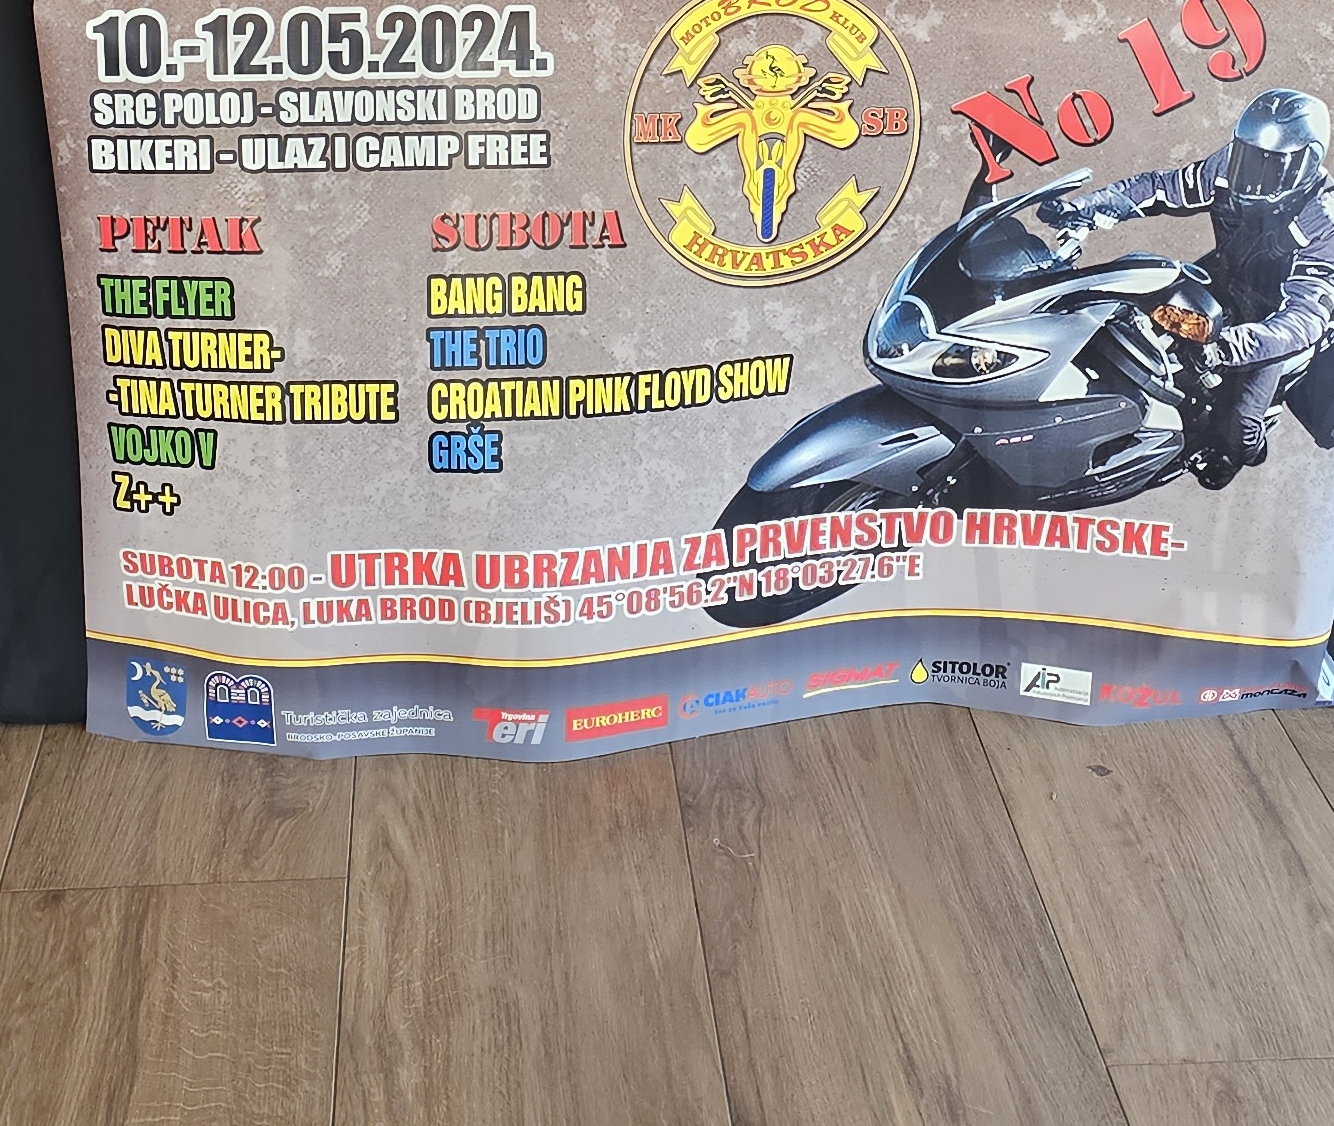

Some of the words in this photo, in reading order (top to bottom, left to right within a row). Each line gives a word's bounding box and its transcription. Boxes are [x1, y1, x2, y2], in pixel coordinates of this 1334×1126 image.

[86, 5, 555, 82] 10.-12.05.2024.
[679, 10, 722, 47] MOTO
[829, 9, 868, 45] KLUB
[91, 90, 155, 128] SRC
[162, 89, 256, 128] POLOJ
[278, 87, 447, 127] SLAVONSKI
[454, 84, 540, 124] BROD
[861, 107, 909, 136] SB
[633, 113, 682, 142] MK
[953, 74, 1114, 184] No
[90, 137, 213, 173] BIKERI
[241, 134, 331, 171] ULAZ
[336, 136, 348, 170] I
[353, 132, 461, 171] CAMP
[470, 131, 549, 167] FREE
[97, 214, 264, 255] PETAK
[431, 210, 626, 252] SUBOTA
[682, 223, 857, 273] HRVATSKA
[101, 278, 149, 316] THE
[156, 277, 233, 316] FLYER
[430, 277, 506, 315] BANG
[513, 276, 583, 314] BANG
[104, 331, 163, 368] DIVA
[169, 330, 283, 368] TURNER-
[431, 331, 478, 368] THE
[485, 330, 544, 366] TRIO
[107, 385, 176, 420] -TINA
[182, 384, 284, 421] TURNER
[290, 384, 397, 421] TRIBUTE
[430, 381, 560, 421] CROATIAN
[568, 377, 631, 415] PINK
[638, 370, 712, 412] FLOYD
[719, 358, 793, 399] SHOW
[112, 430, 194, 465] VOJKO
[198, 432, 216, 467] V
[432, 427, 500, 471] GRŠE
[113, 476, 180, 513] Z++
[123, 551, 227, 585] SUBOTA
[231, 563, 305, 590] 12:00
[330, 552, 463, 588] UTRKA
[475, 542, 672, 588] UBRZANJA
[683, 535, 729, 568] ZA
[737, 511, 954, 563] PRVENSTVO
[966, 512, 1185, 559] HRVATSKE-
[126, 582, 207, 615] LUČKA
[214, 595, 296, 629] ULICA,
[303, 600, 371, 626] LUKA
[380, 599, 456, 626] BROD
[464, 595, 570, 625] (BJELIŠ)
[807, 662, 900, 690] SIGMAT
[931, 661, 1005, 679] SITOLOR
[931, 675, 980, 687] TVORNICA
[982, 678, 1007, 690] BOJA
[282, 708, 368, 727] Turistička
[373, 706, 454, 724] zajednica
[572, 705, 663, 731] EUROHERC
